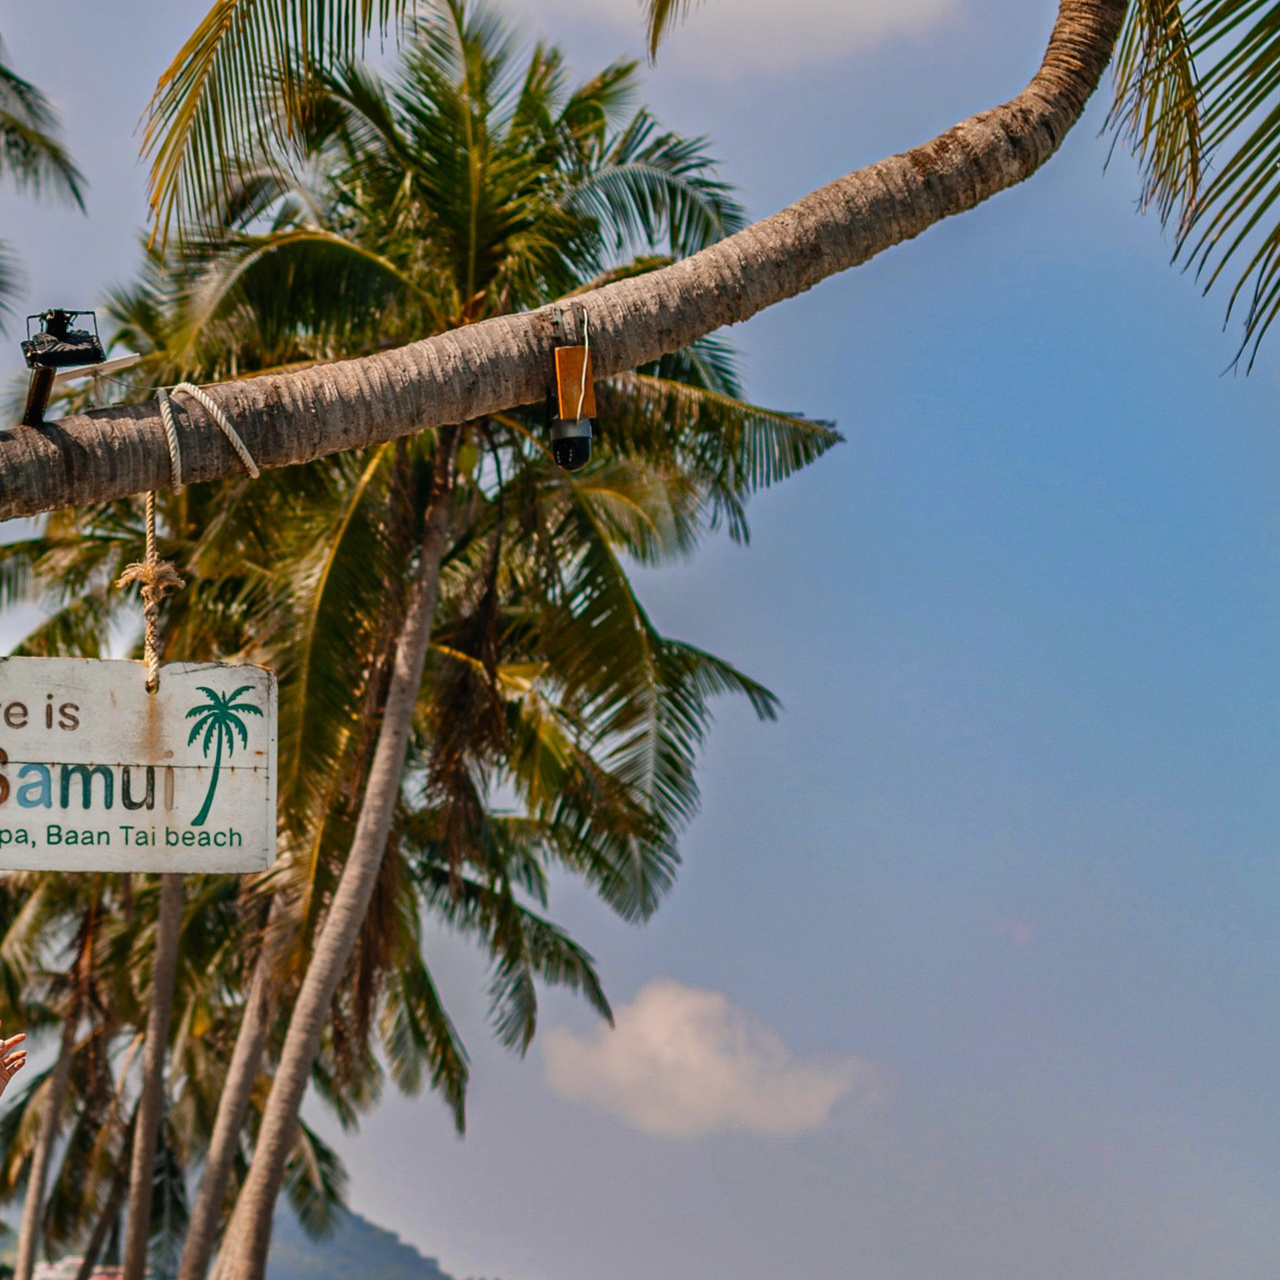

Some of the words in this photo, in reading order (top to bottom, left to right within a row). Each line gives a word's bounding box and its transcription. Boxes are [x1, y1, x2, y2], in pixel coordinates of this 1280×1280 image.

[45, 693, 81, 731] is
[47, 824, 111, 846] Baan
[120, 826, 156, 847] Tai
[165, 826, 242, 848] beach
